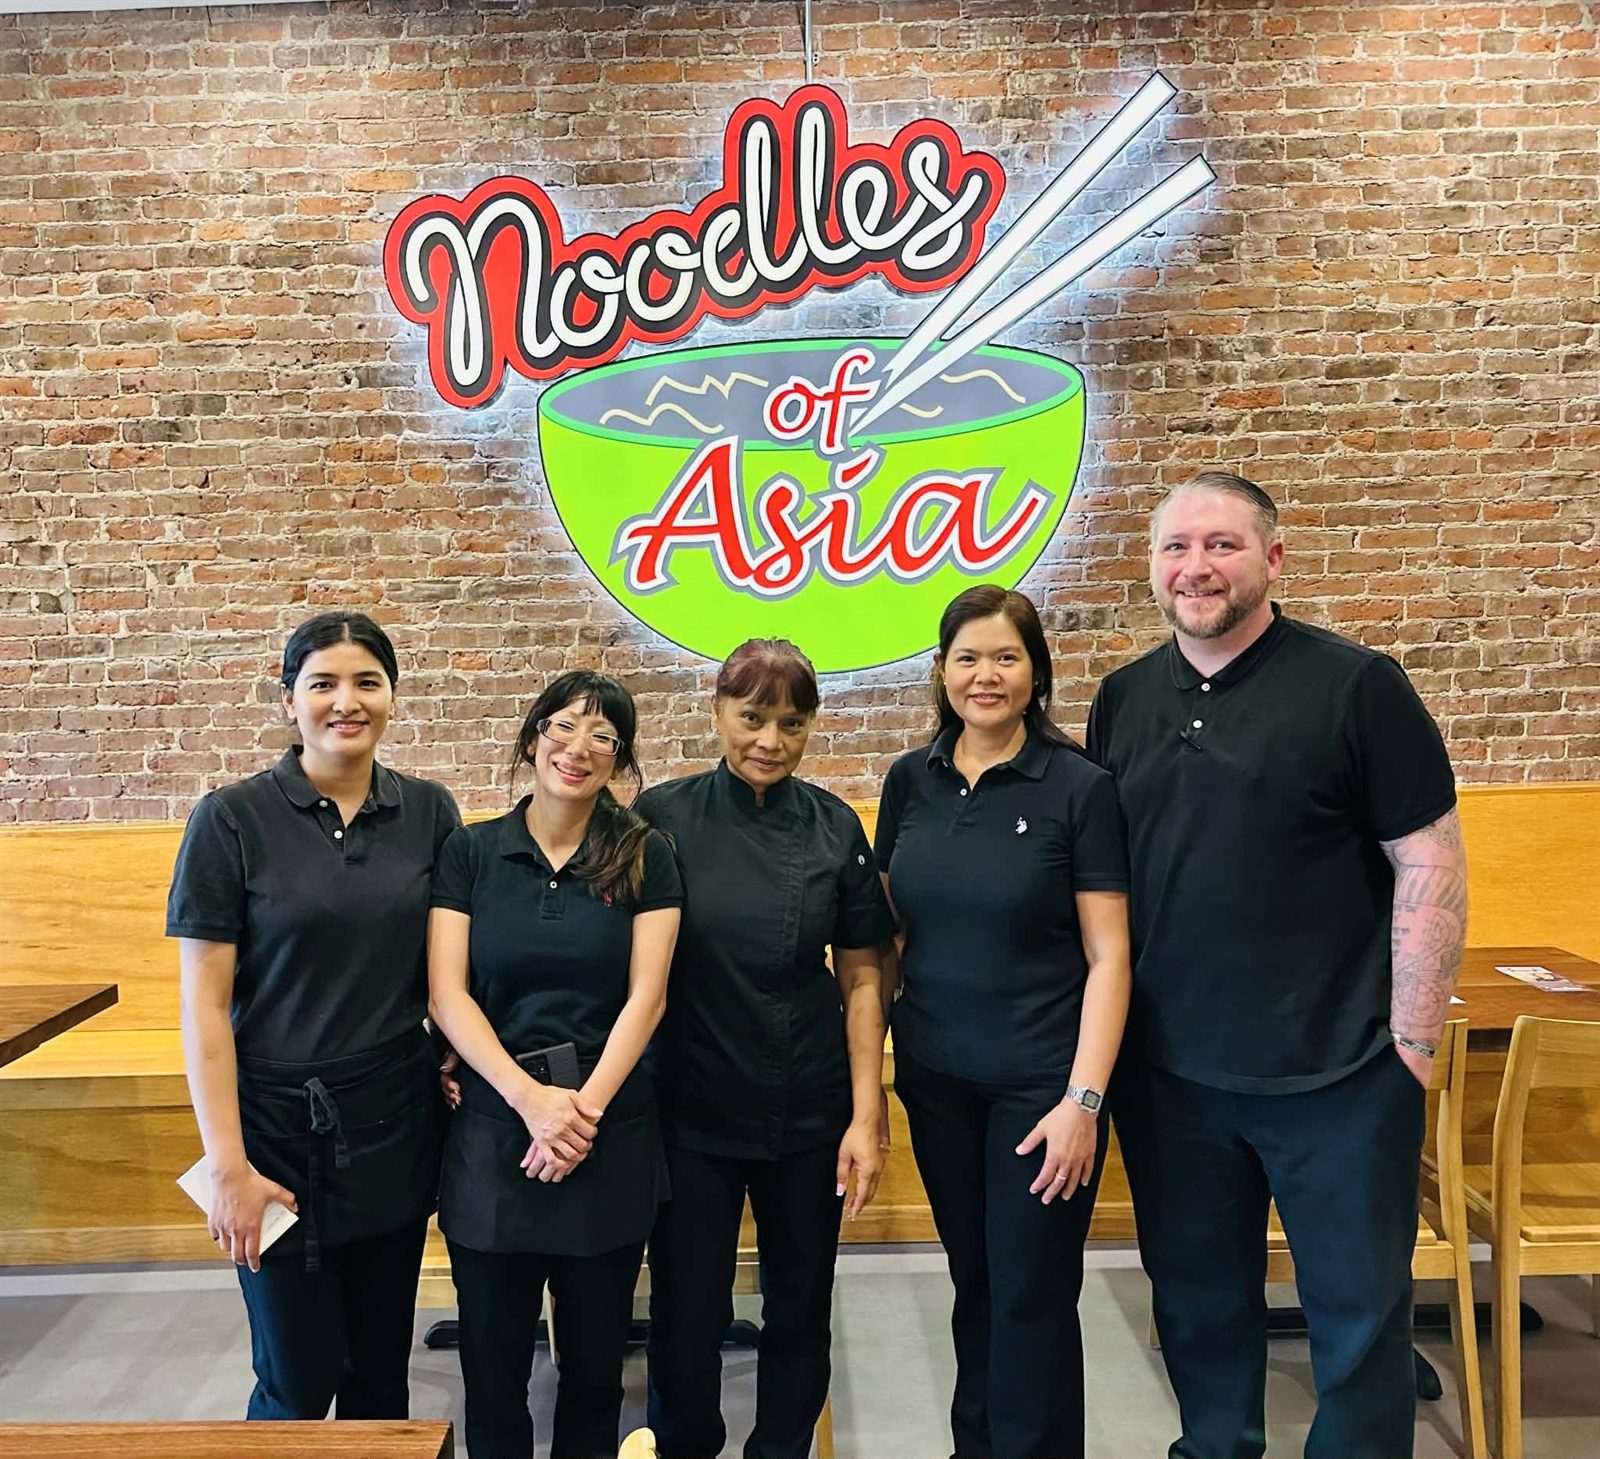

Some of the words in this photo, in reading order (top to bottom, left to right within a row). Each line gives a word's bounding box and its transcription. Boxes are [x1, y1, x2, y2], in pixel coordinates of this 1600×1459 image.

[402, 101, 986, 390] Noodles
[765, 345, 877, 450] of
[623, 439, 1050, 590] Asia
